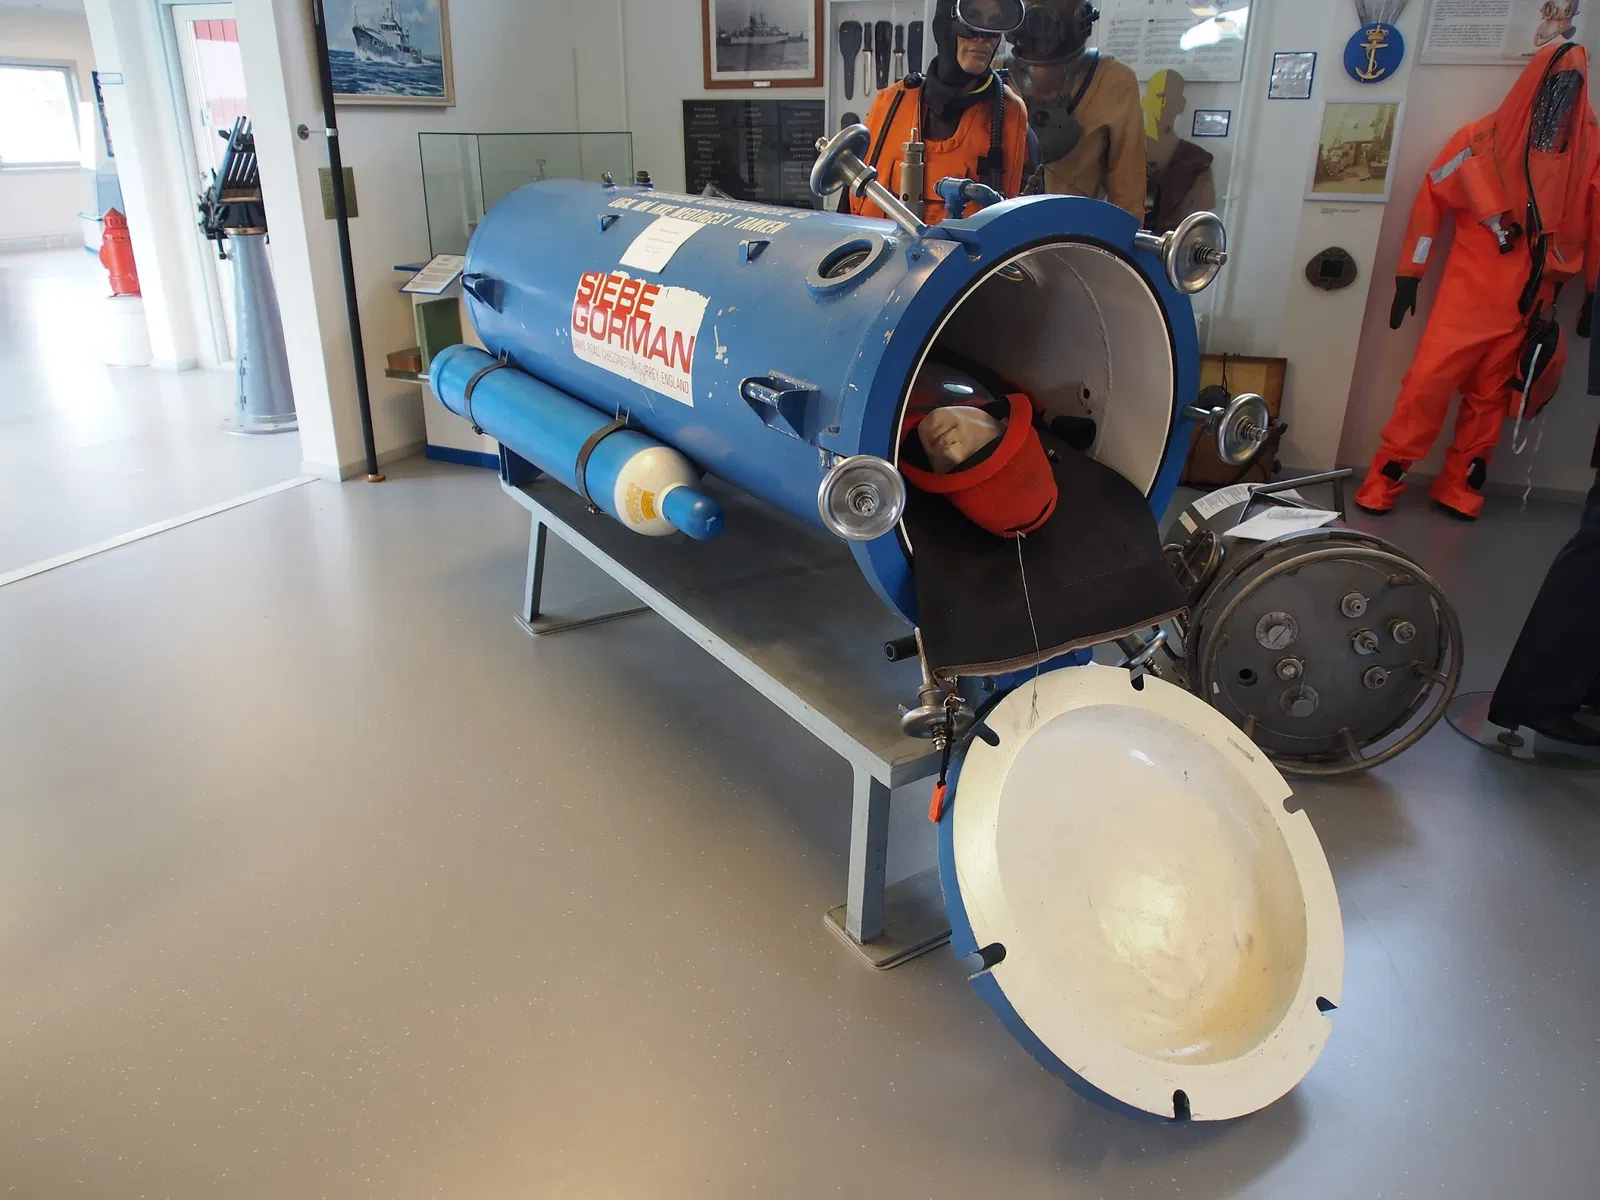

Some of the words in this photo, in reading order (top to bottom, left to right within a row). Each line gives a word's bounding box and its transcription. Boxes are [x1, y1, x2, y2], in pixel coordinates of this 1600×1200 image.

[733, 216, 791, 235] TANKEN
[577, 271, 661, 323] SIEBE
[572, 302, 696, 375] GORMAN
